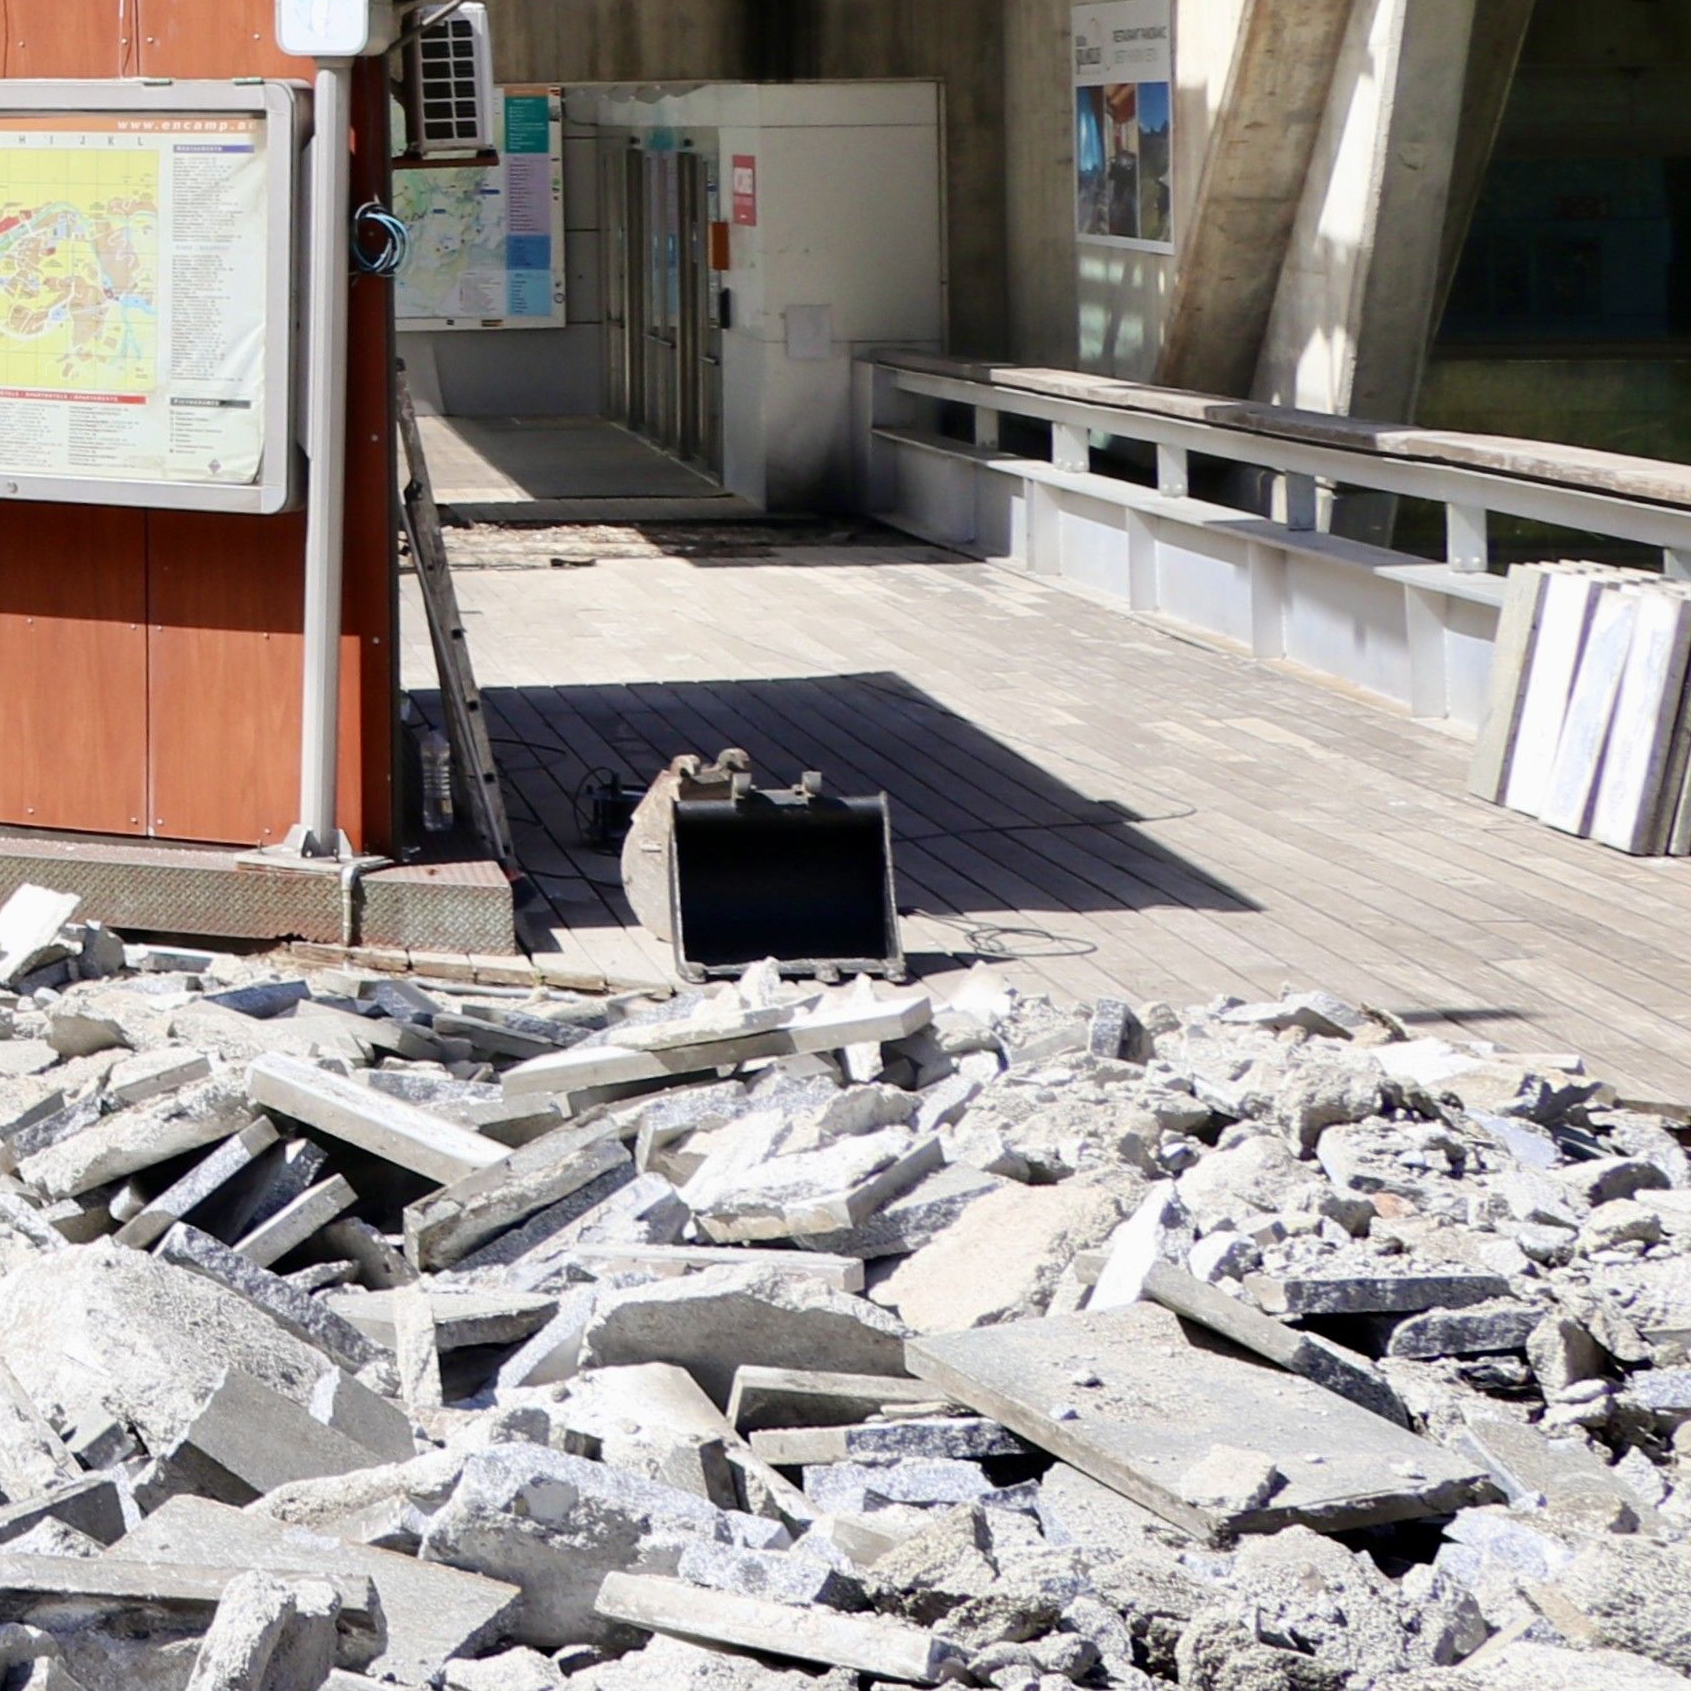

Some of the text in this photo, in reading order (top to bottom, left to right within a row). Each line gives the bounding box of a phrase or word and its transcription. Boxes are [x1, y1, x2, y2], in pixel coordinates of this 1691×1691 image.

[19, 134, 25, 144] H
[80, 136, 85, 145] J
[108, 136, 115, 145] K
[137, 136, 143, 146] L
